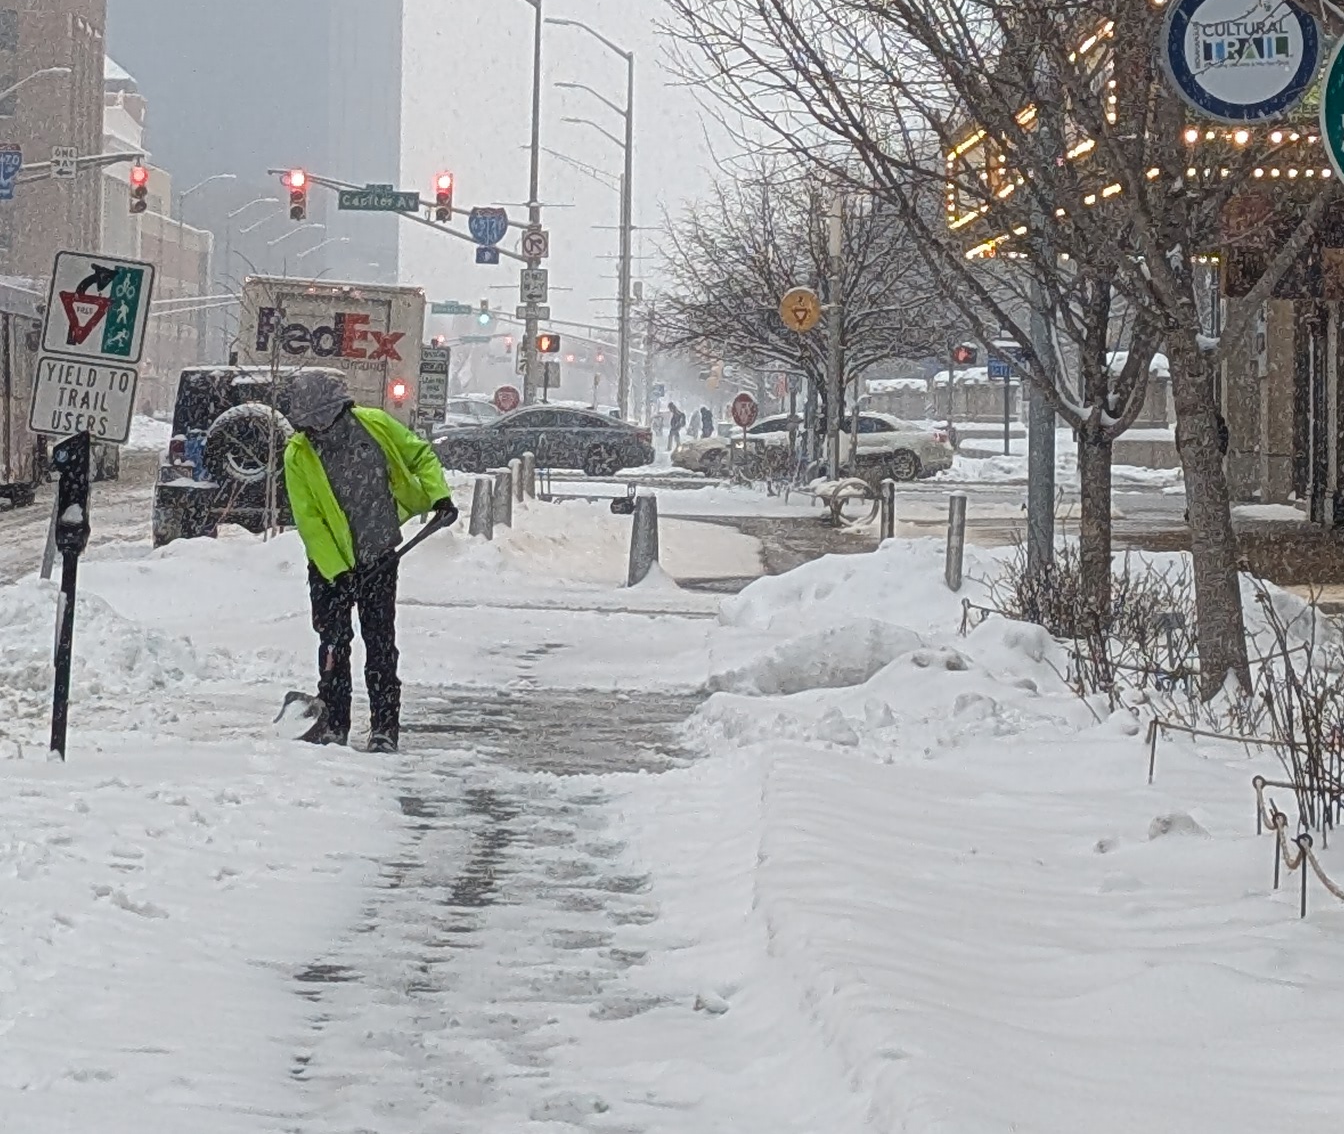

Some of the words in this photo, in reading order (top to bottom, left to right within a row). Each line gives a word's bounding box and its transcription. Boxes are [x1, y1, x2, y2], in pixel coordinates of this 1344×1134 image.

[1202, 20, 1289, 37] CULTURAL
[1201, 36, 1289, 61] TRAIL
[5, 153, 20, 165] 70
[255, 306, 406, 361] FedEx
[46, 363, 97, 388] YIELD
[109, 371, 130, 393] TO
[58, 387, 108, 411] TRAIL
[51, 409, 109, 435] USERS
